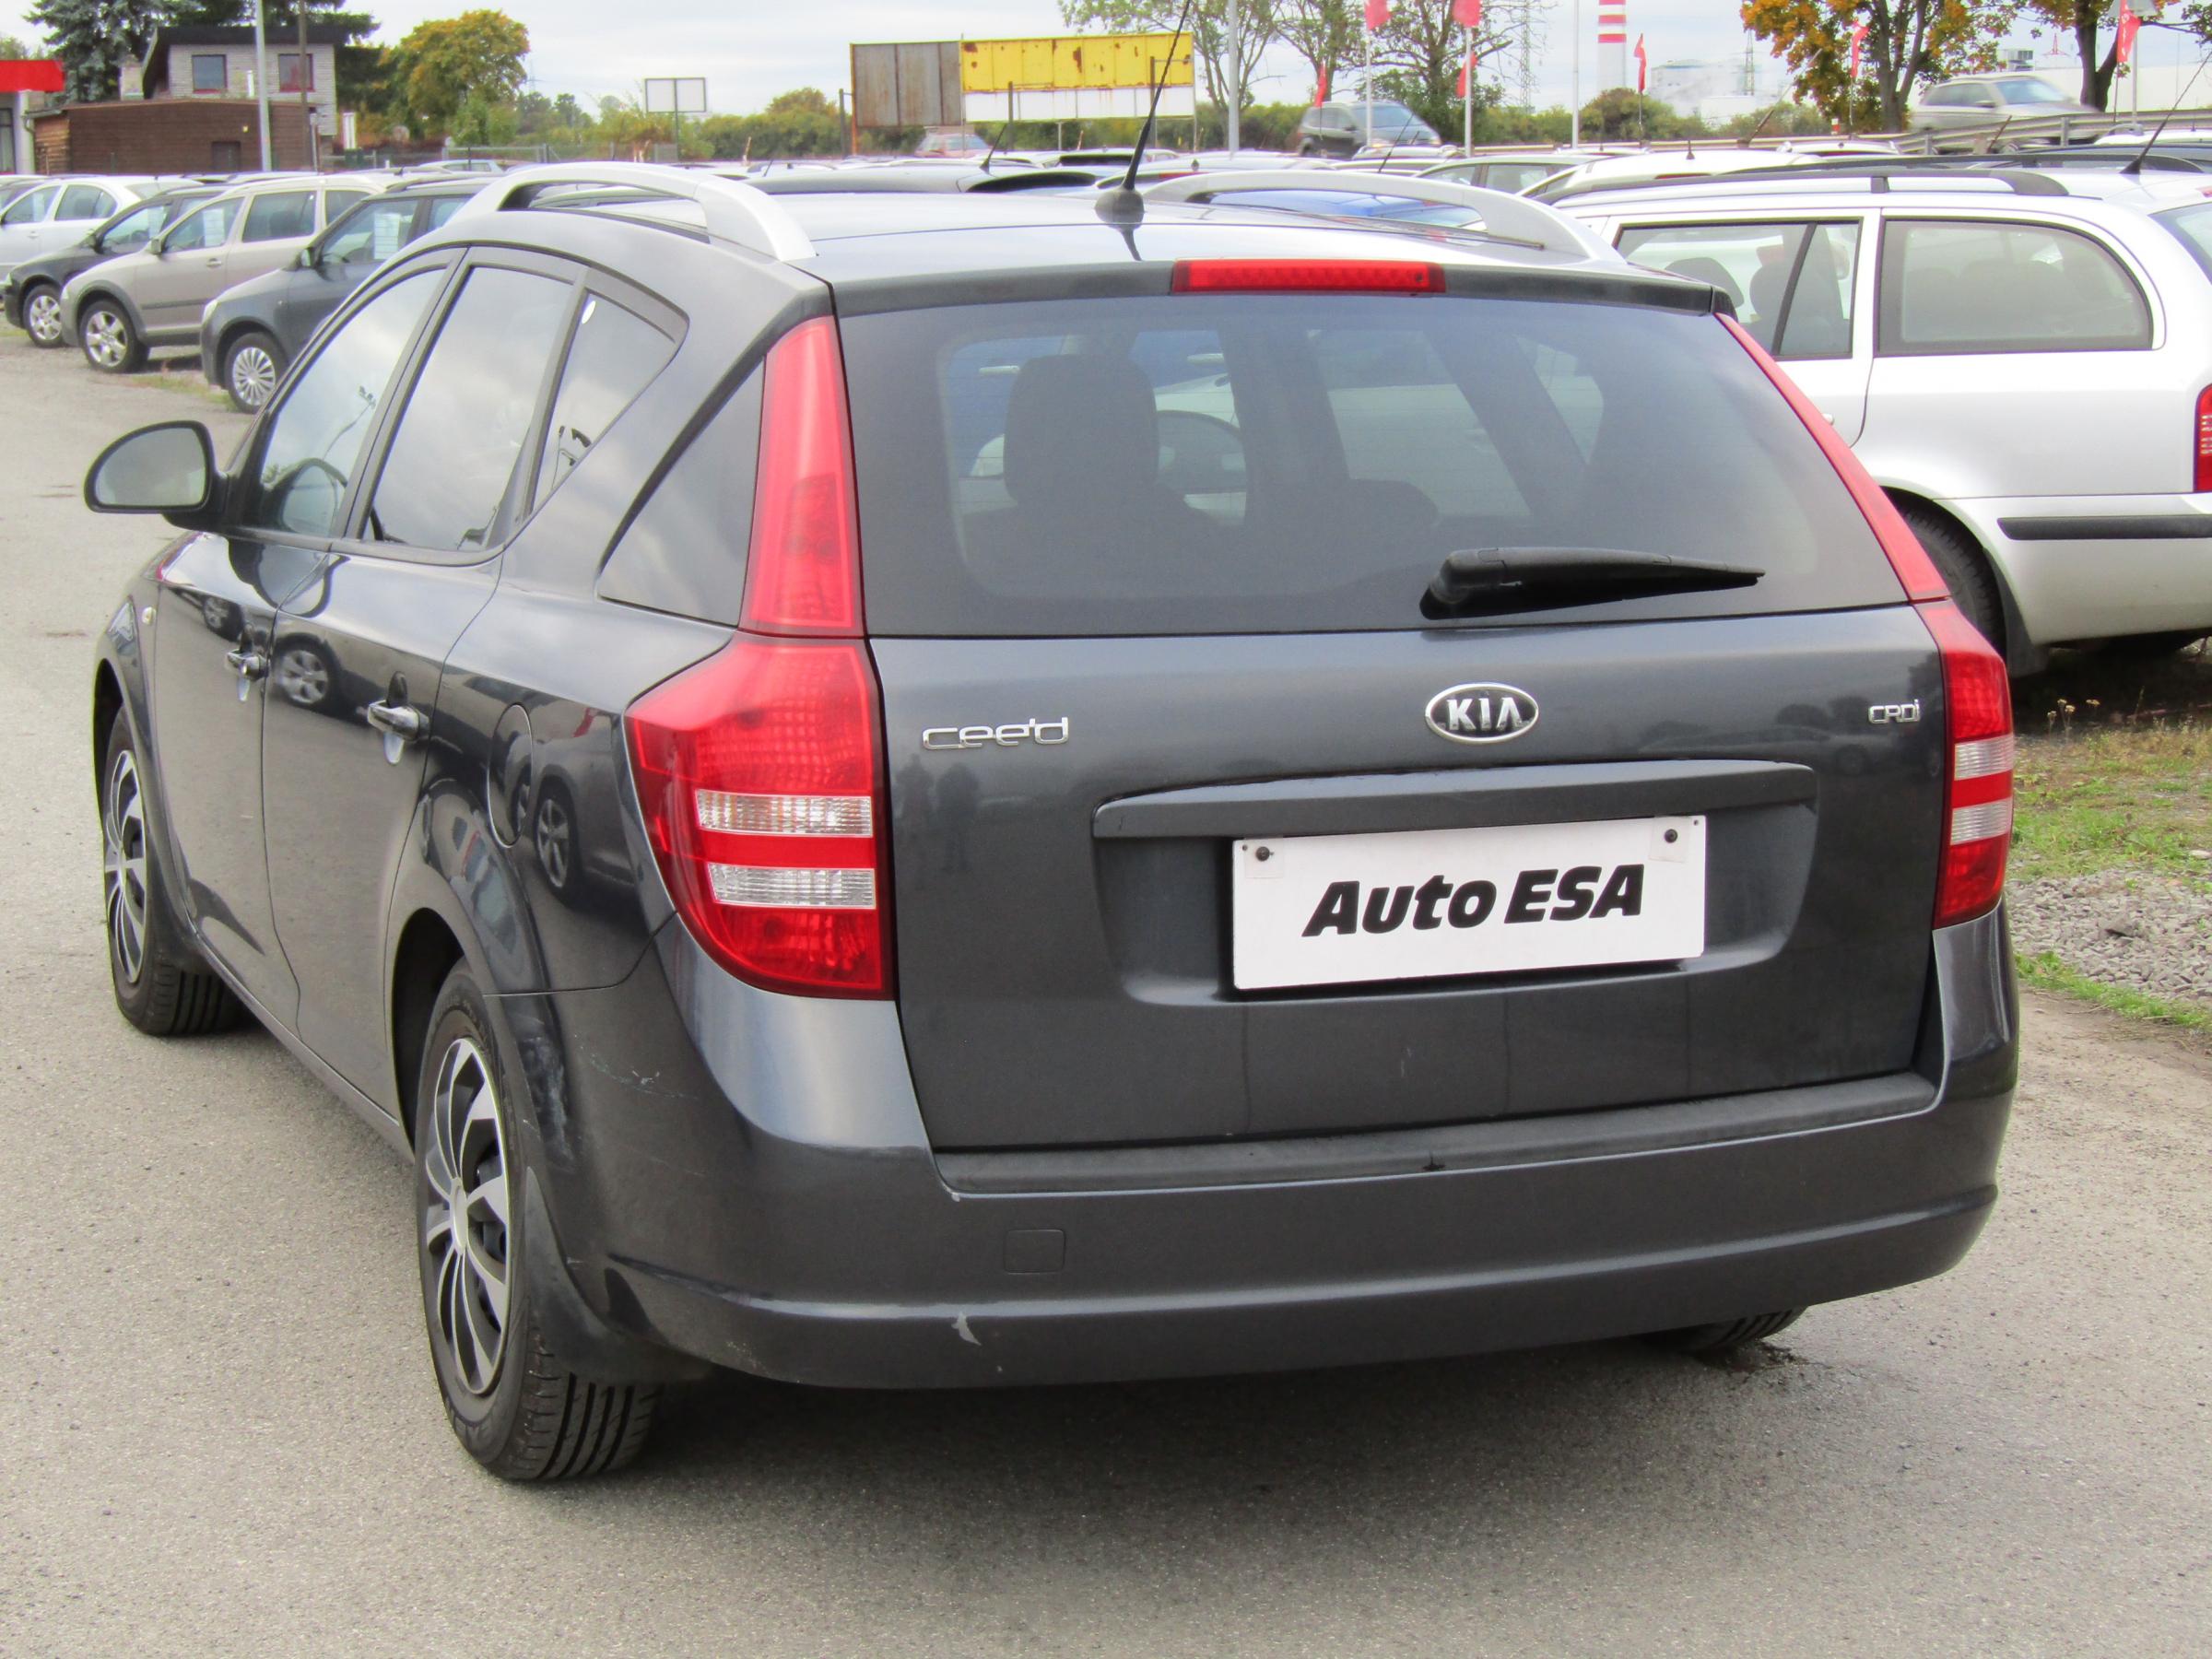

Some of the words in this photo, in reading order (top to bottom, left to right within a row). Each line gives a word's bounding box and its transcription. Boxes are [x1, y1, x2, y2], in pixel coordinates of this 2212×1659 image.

[1446, 697, 1524, 732] KIA
[1301, 875, 1497, 937] Auto
[1503, 864, 1645, 924] ESA
